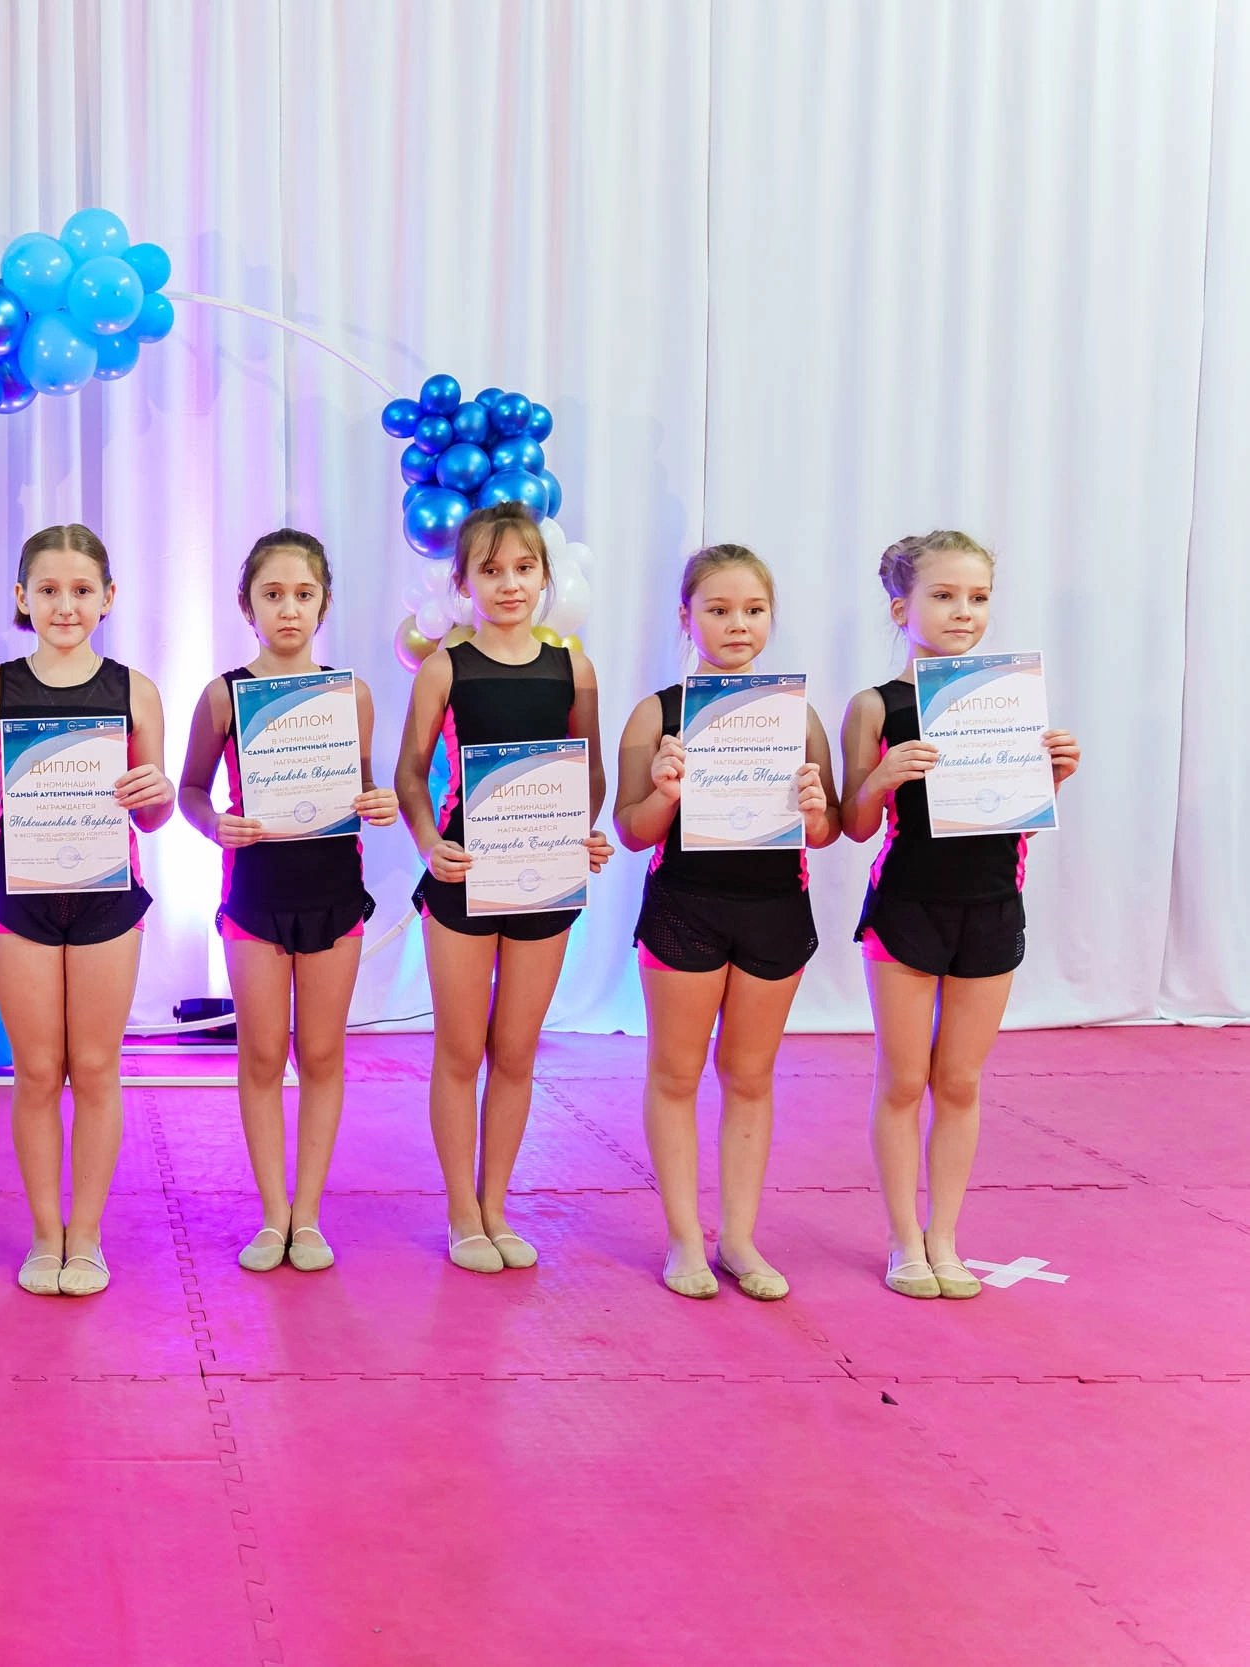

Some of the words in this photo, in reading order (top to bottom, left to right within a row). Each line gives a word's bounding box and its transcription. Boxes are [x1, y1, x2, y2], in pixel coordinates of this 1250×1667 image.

[948, 696, 1019, 712] ДИПЛОМ
[265, 714, 333, 733] ДИПЛОМ
[709, 715, 780, 730] ДИПЛОМ
[963, 718, 1015, 726] НОМИНАЦИИ
[960, 726, 1013, 736] АУТЕНТИЧНЫЙ
[279, 734, 329, 743] НОМИНАЦИИ
[957, 740, 1017, 749] НАГРАЖДАЕТСЯ
[277, 742, 327, 754] АУТЕНТИЧНЫЙ
[274, 755, 331, 766] НАГРАЖДАЕТСЯ
[996, 750, 1044, 767] Валерия
[30, 760, 100, 775] ДИПЛОМ
[311, 763, 357, 781] Вероника
[690, 768, 749, 787] Кузнецова
[753, 767, 792, 786] Мария
[491, 783, 562, 799] ДИПЛОМ
[505, 803, 557, 812] НОМИНАЦИИ
[9, 816, 77, 827] Максименкова
[81, 815, 122, 829] Варвара
[501, 812, 555, 820] АУТЕНТИЧНЫЙ
[498, 825, 557, 833] НАГРАЖДАЕТСЯ
